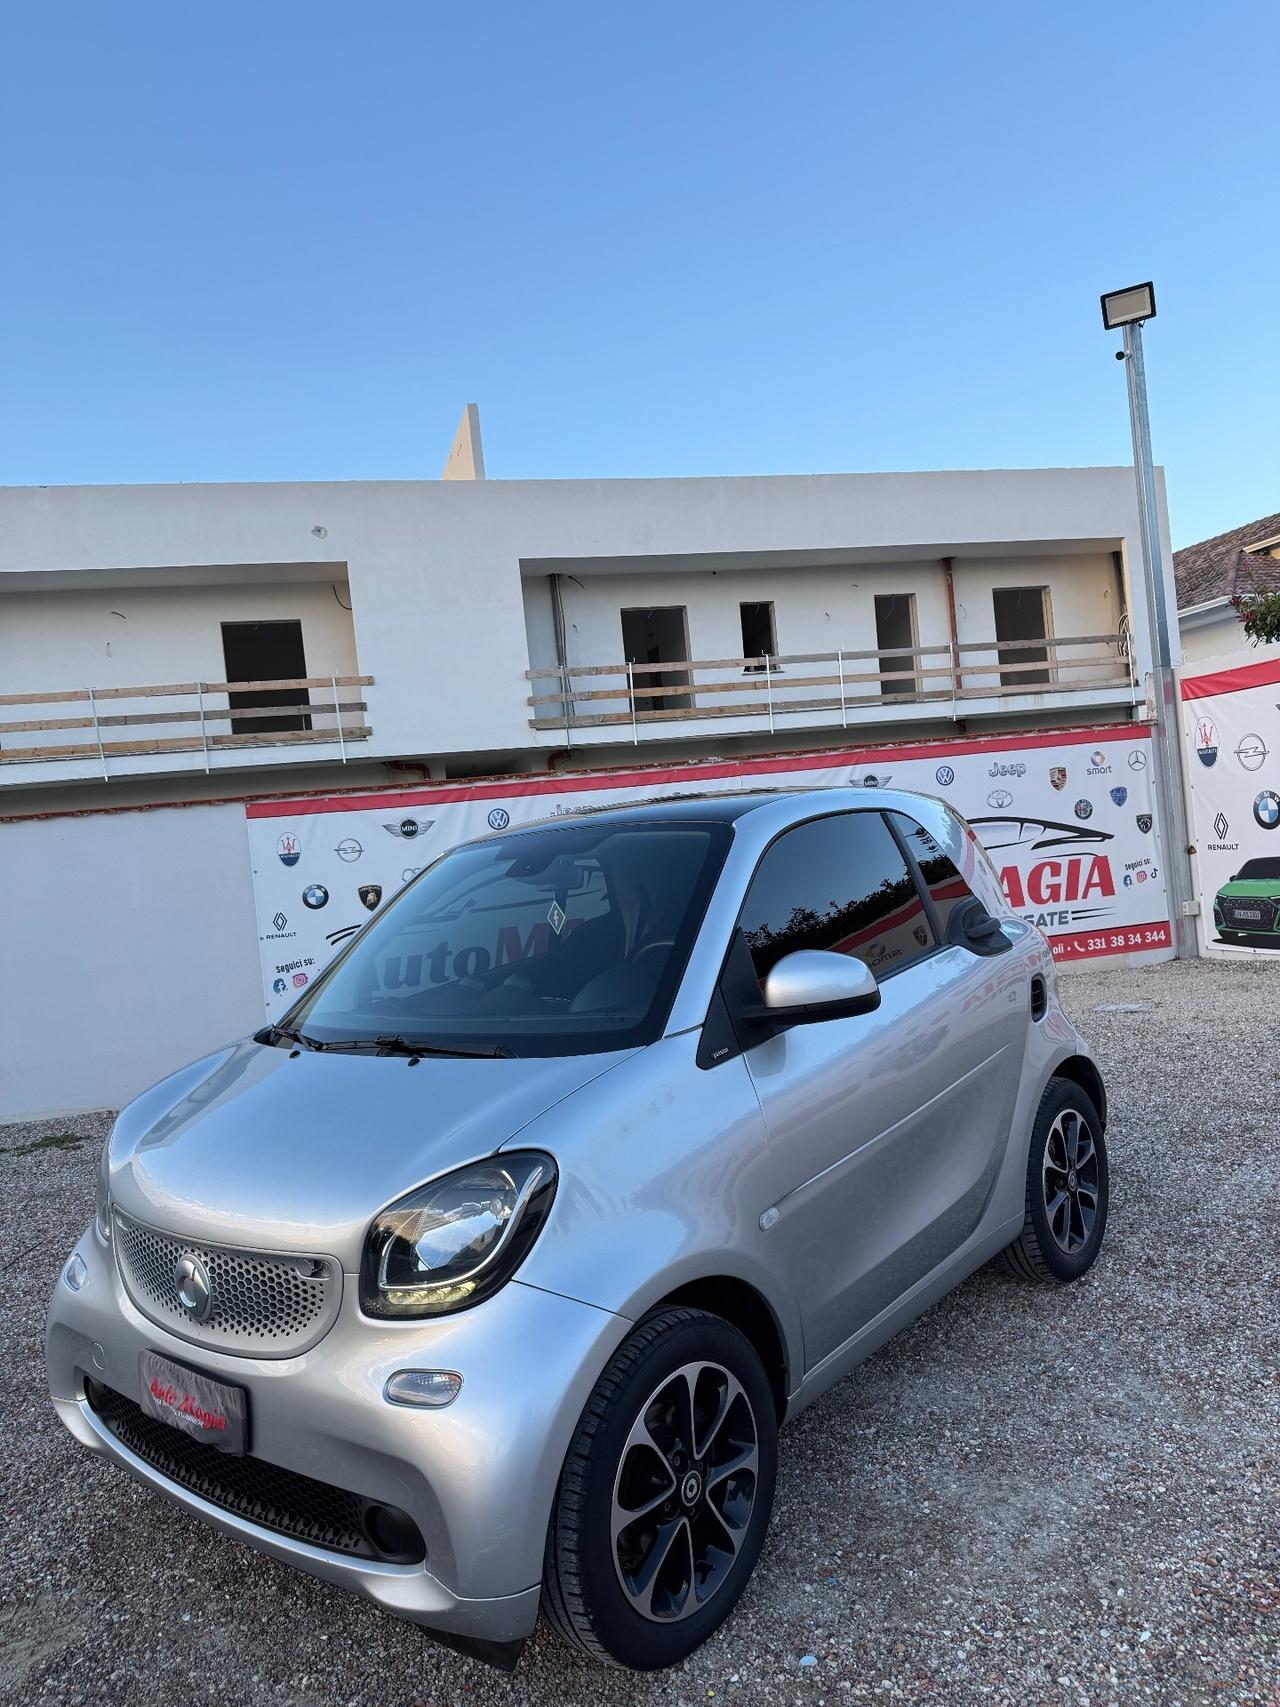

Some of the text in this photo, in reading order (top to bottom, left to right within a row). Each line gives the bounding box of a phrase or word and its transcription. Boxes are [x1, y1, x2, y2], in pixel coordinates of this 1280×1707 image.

[988, 762, 1027, 777] Jeep
[1086, 765, 1113, 776] smart
[1207, 843, 1240, 851] RENAULT
[1020, 910, 1069, 928] SATE
[266, 931, 297, 940] RENAULT
[1087, 937, 1107, 951] 331
[1110, 935, 1125, 948] 38
[1128, 933, 1142, 945] 34
[1145, 930, 1166, 943] 344
[275, 958, 303, 974] Seguici
